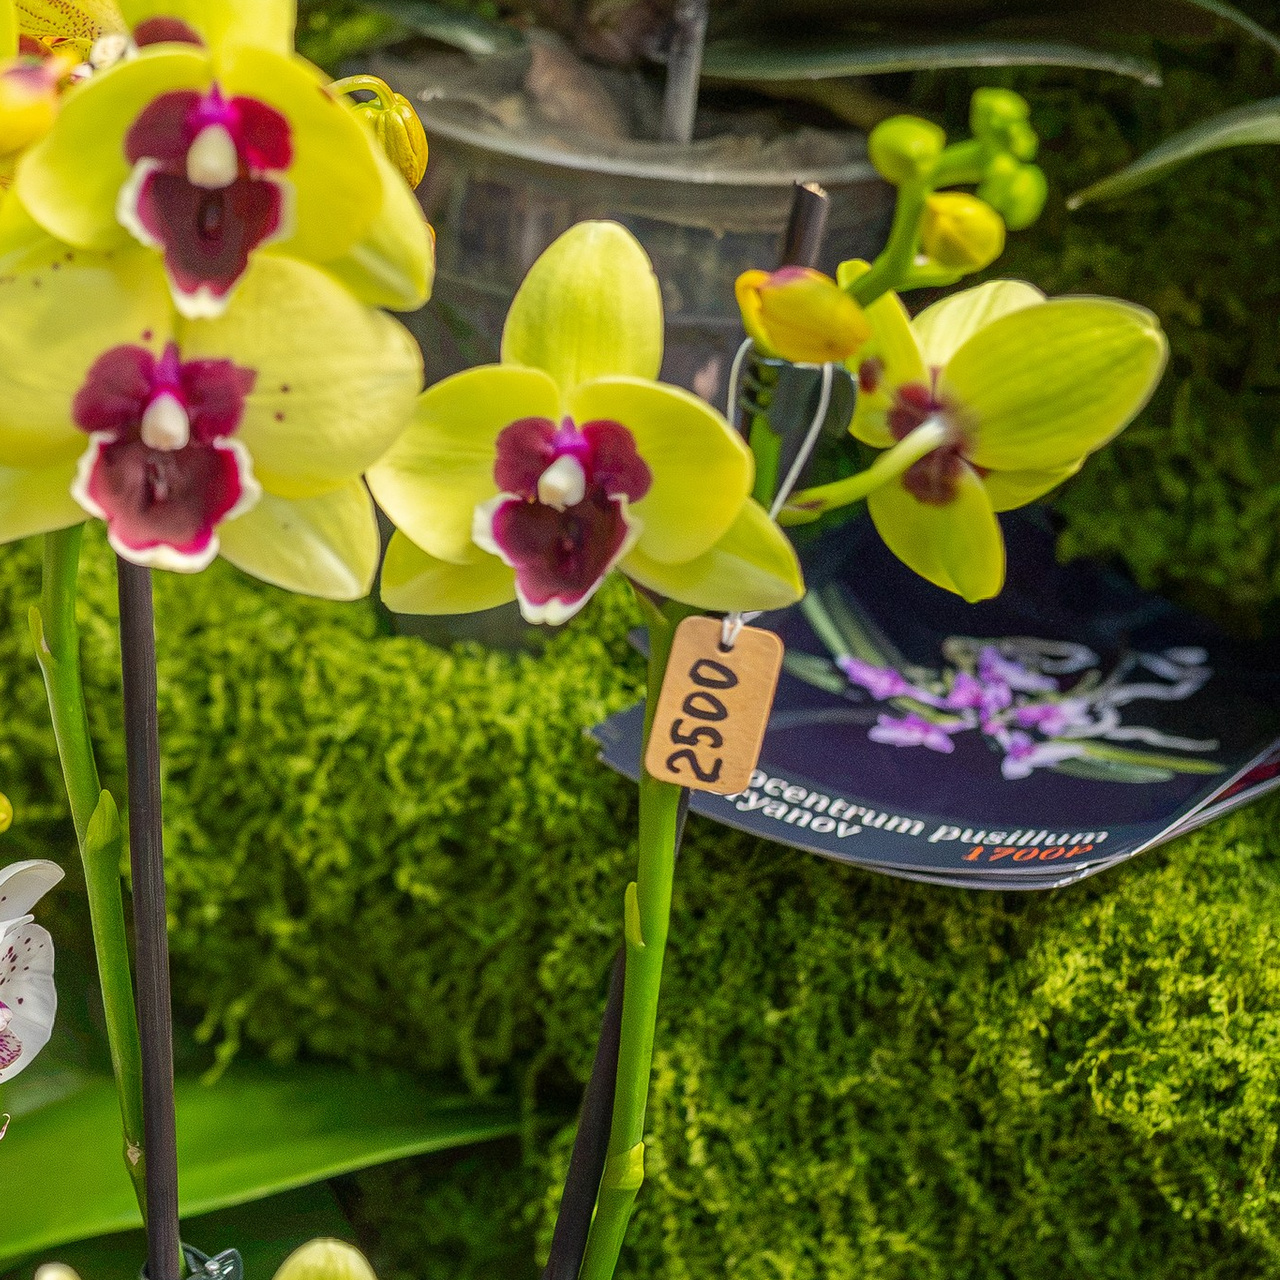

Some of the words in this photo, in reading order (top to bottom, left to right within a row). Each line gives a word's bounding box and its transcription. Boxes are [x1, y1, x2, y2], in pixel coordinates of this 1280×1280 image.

[666, 658, 739, 783] 2500
[749, 769, 925, 836] ocentrum
[927, 824, 1109, 846] pusillum
